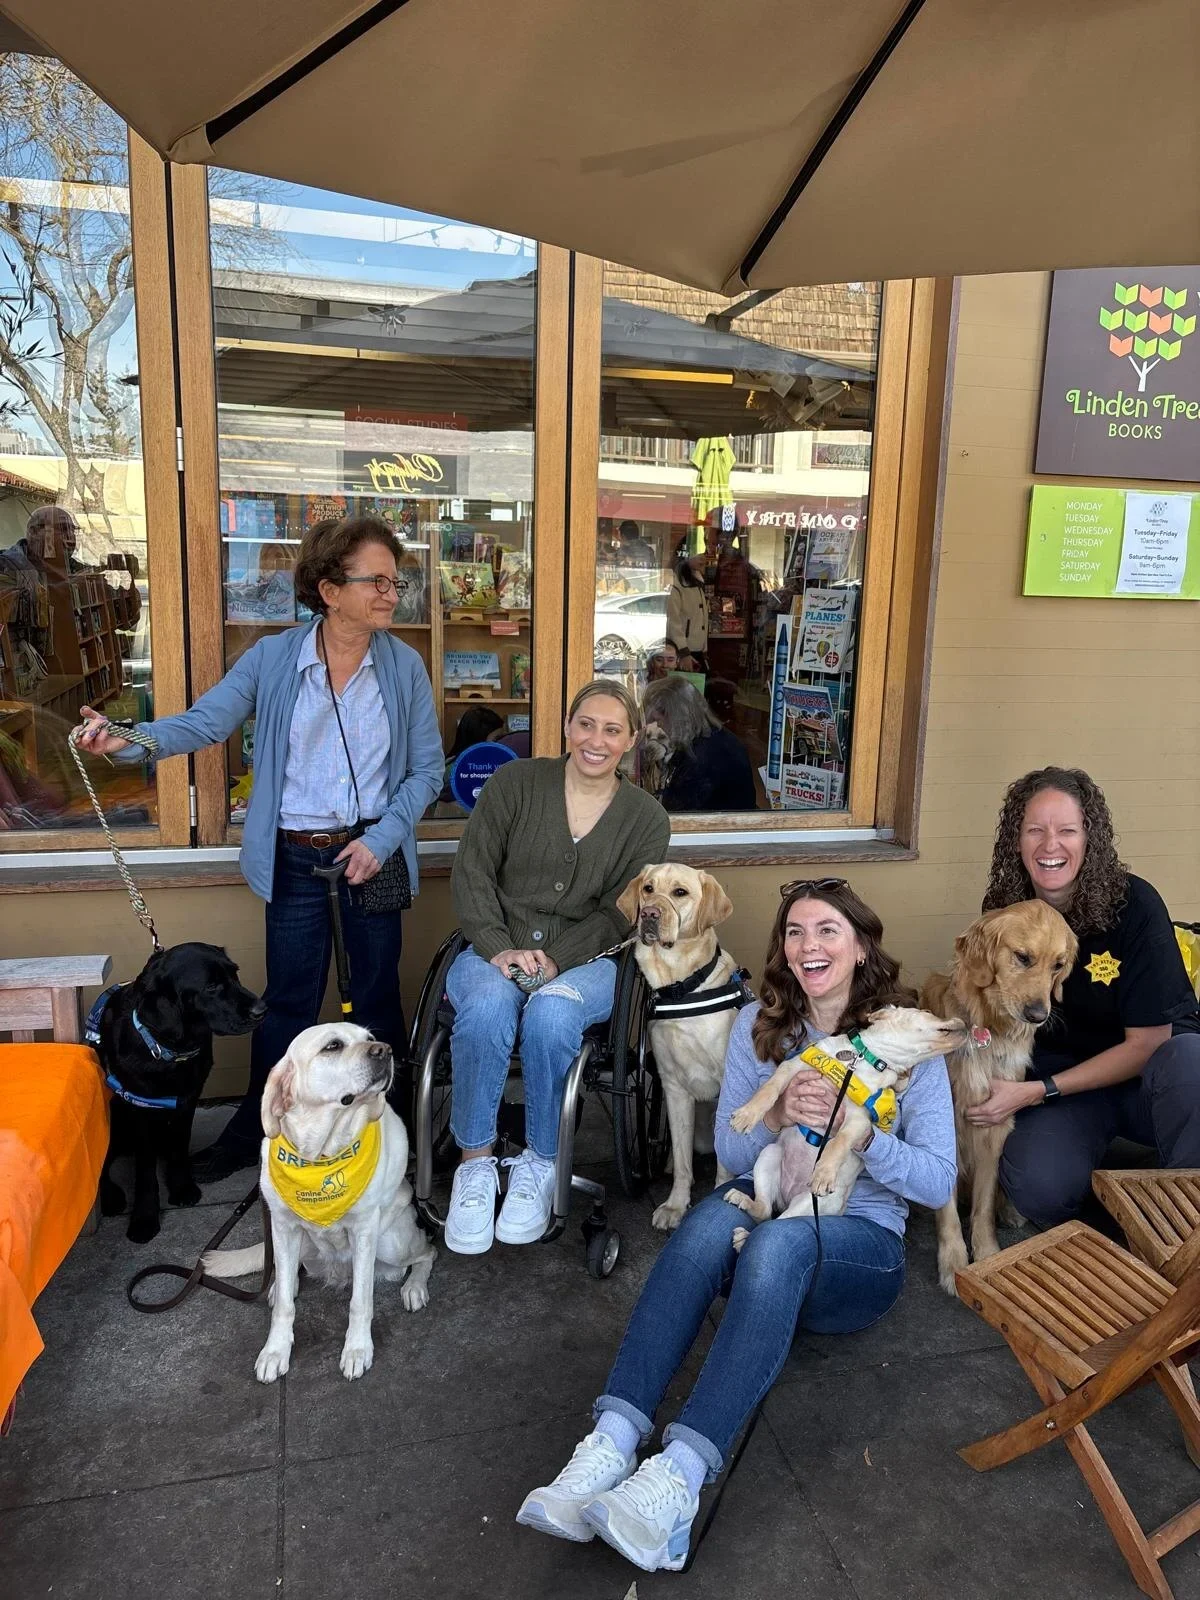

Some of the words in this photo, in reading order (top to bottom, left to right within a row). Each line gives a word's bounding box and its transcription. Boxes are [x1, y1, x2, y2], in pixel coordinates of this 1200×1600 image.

[1066, 389, 1148, 418] Linden
[1153, 394, 1200, 420] Tre
[1108, 423, 1162, 440] BOOKS
[1066, 501, 1103, 511] MONDAY
[1065, 513, 1099, 523] TUESDAY
[1064, 525, 1113, 535] WEDNESDAY
[1134, 528, 1178, 538] Tuesday-Friday
[1062, 537, 1104, 547] THURSDAY
[1061, 549, 1089, 558] FRIDAY
[1128, 553, 1179, 562] Saturday-Sunday
[1060, 561, 1100, 571] SATURDAY
[1059, 572, 1092, 582] SUNDAY
[468, 762, 493, 770] Thank
[785, 786, 825, 802] TRUCKS!
